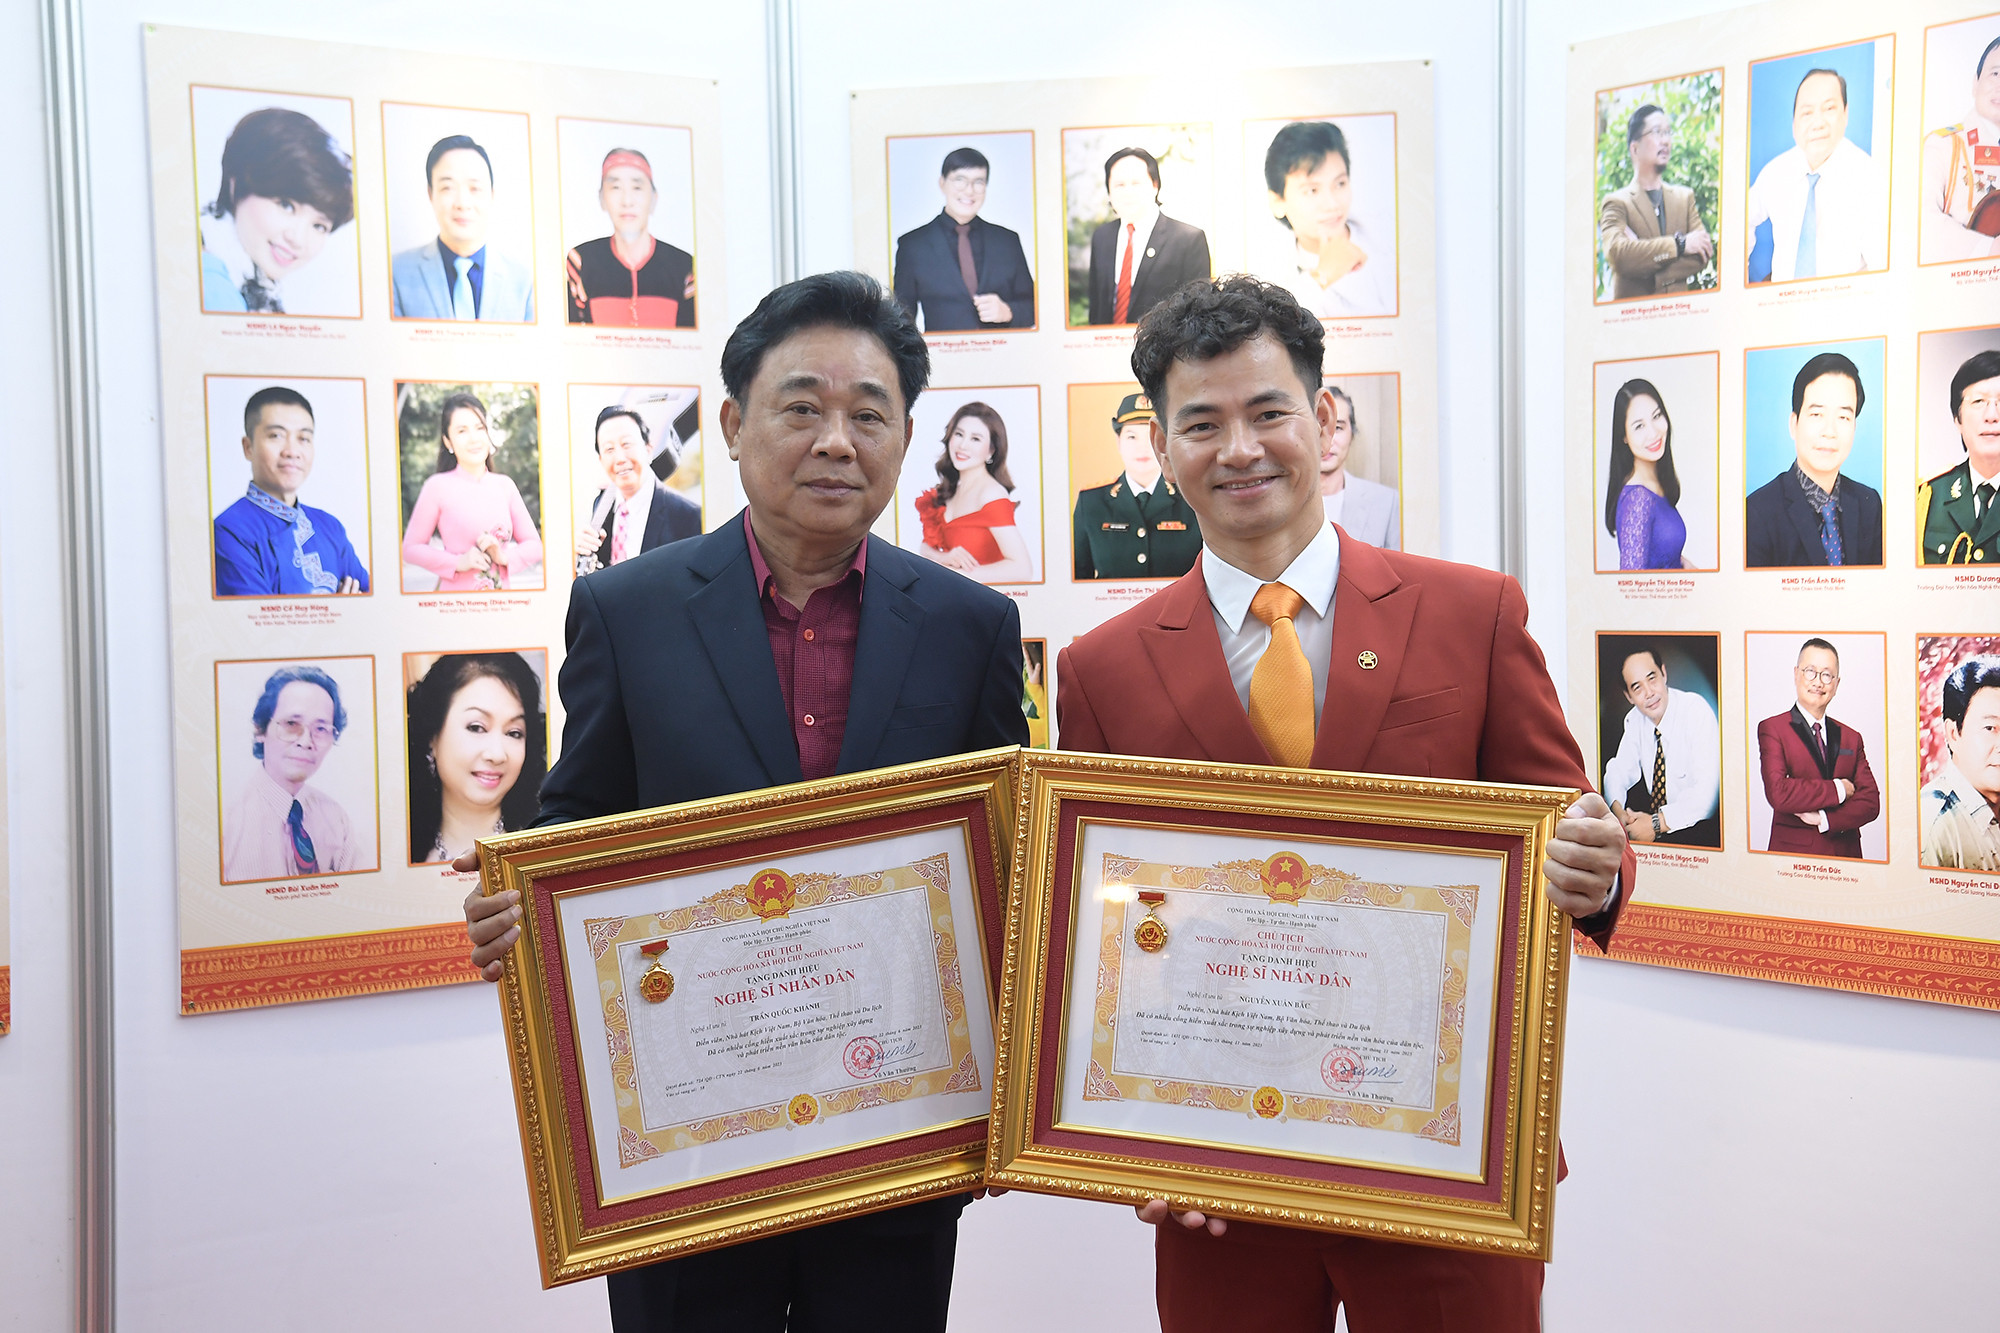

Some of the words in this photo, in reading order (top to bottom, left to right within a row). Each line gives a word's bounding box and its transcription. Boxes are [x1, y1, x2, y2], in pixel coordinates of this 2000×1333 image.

[1929, 877, 1950, 885] NSND
[1195, 935, 1217, 944] NƯỚC
[1217, 937, 1240, 946] CỘNG
[1241, 939, 1258, 948] HÒA
[1258, 941, 1269, 949] XÃ
[1270, 943, 1285, 951] HỘI
[1286, 944, 1301, 953] CHỦ
[1304, 946, 1329, 955] NGHĨA
[1330, 948, 1348, 958] VIỆT
[1350, 950, 1367, 959] NAM
[1257, 931, 1276, 941] CHỦ
[1281, 933, 1304, 944] TỊCH
[697, 970, 719, 980] NƯỚC
[720, 966, 742, 976] CỘNG
[743, 962, 760, 971] HÒA
[760, 959, 771, 968] XÃ
[772, 957, 786, 966] HỘI
[787, 954, 803, 963] CHỦ
[804, 948, 828, 959] NGHĨA
[828, 945, 845, 954] VIỆT
[847, 942, 864, 950] NAM
[756, 947, 776, 959] CHỦ
[780, 943, 803, 956] TỊCH
[1242, 953, 1266, 963] TẶNG
[1267, 956, 1293, 966] DANH
[1295, 958, 1317, 969] HIỆU
[747, 973, 771, 985] TẶNG
[772, 968, 797, 980] DANH
[798, 963, 819, 975] HIỆU
[1205, 962, 1249, 981] NGHỆ
[1252, 965, 1267, 980] SĨ
[1270, 967, 1315, 984] NHÂN
[1319, 971, 1352, 988] DÂN
[714, 988, 758, 1008] NGHỆ
[760, 982, 775, 998] SĨ
[778, 975, 821, 995] NHÂN
[824, 968, 855, 986] DÂN
[750, 1011, 770, 1022] TRẦN
[770, 1006, 792, 1019] QUỐC
[793, 1002, 820, 1013] KHÁNH
[1239, 995, 1271, 1005] NGUYỄN
[1272, 999, 1293, 1007] XUÂN
[1294, 1000, 1311, 1009] BẮC
